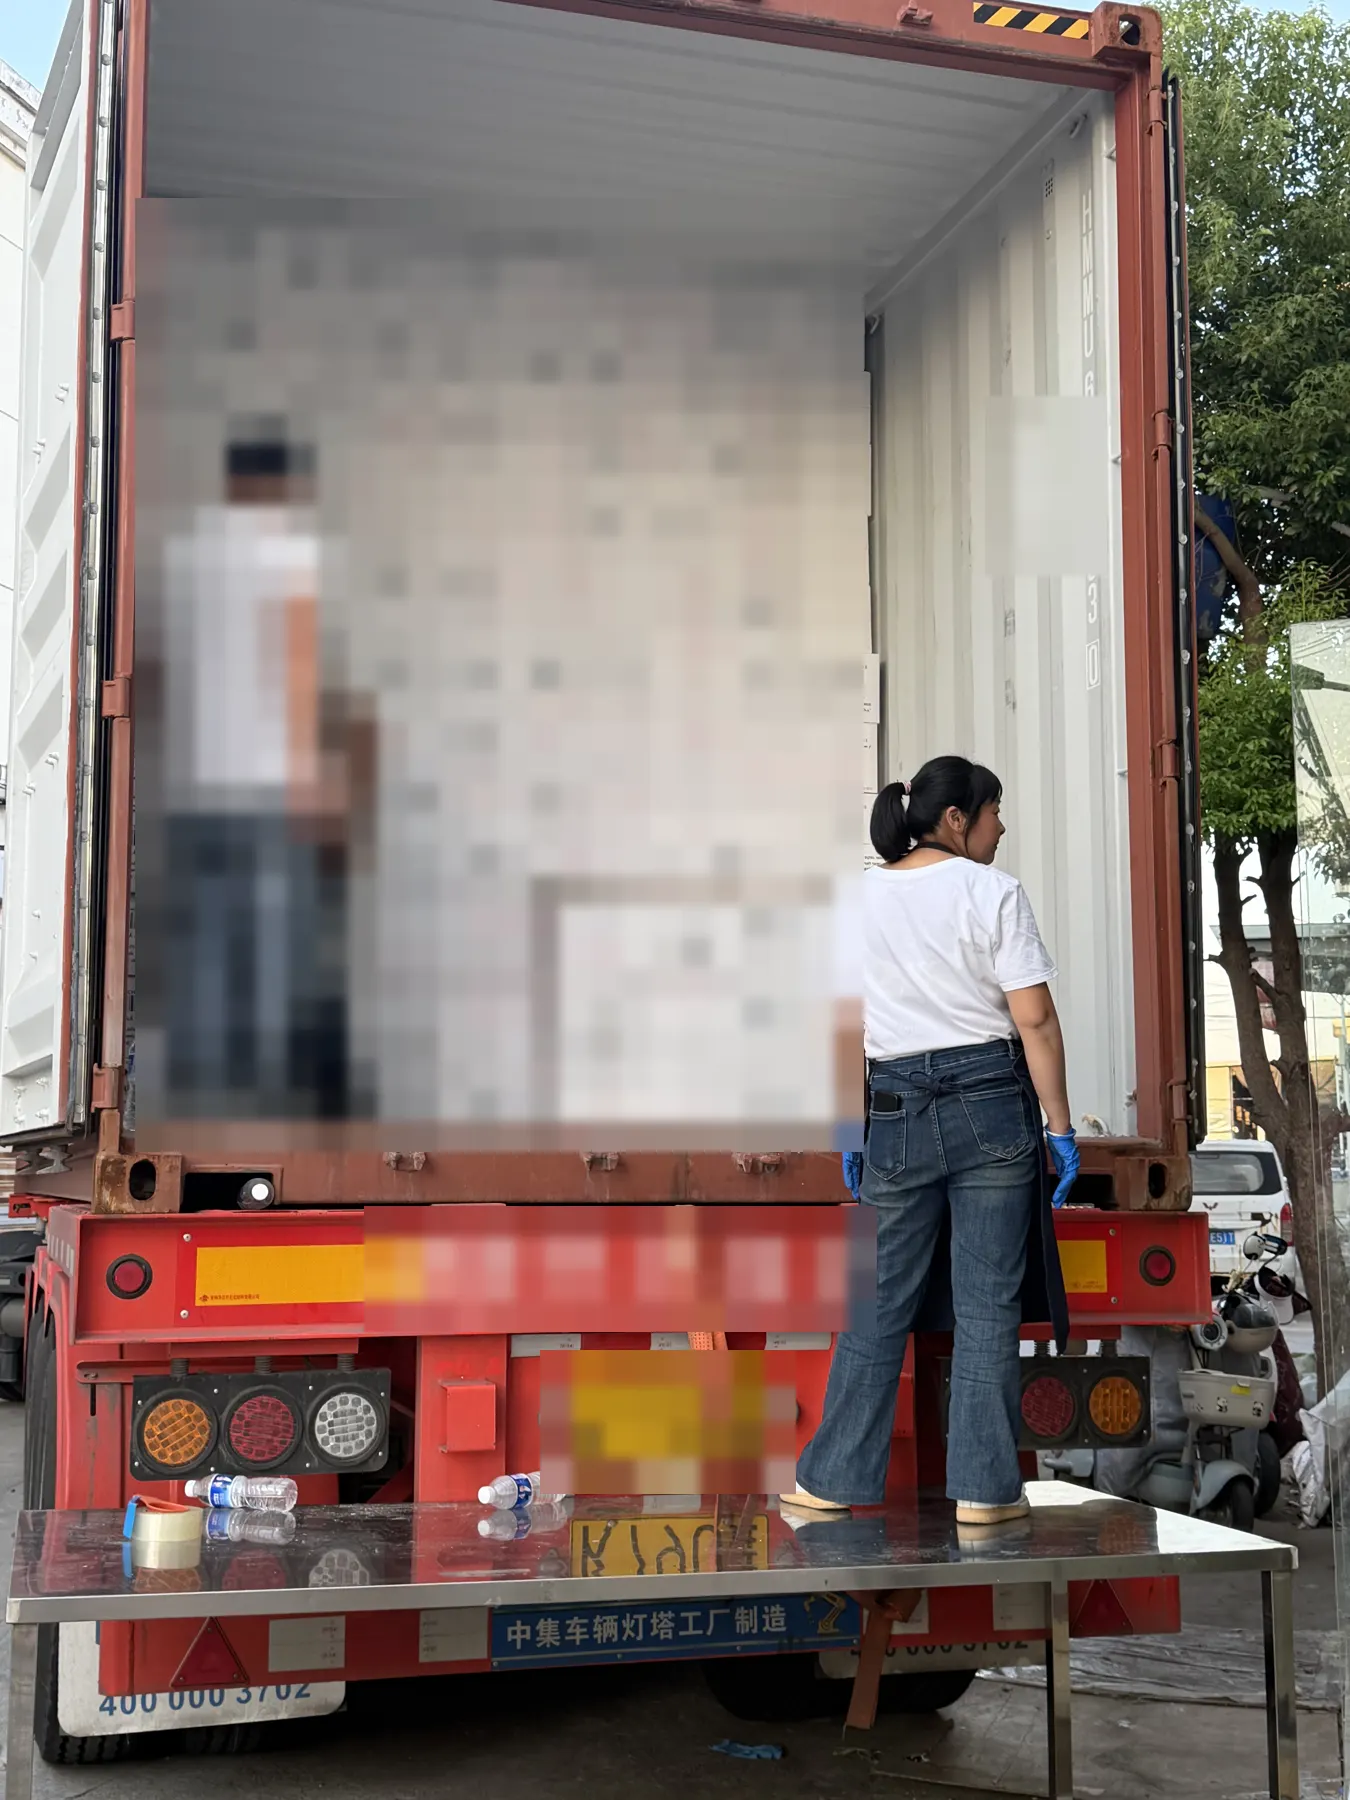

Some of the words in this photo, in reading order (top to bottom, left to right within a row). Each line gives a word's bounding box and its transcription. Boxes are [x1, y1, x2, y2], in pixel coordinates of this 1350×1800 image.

[1082, 189, 1094, 358] HMMU
[506, 1603, 787, 1650] 中集车辆灯塔工厂制造
[99, 1694, 157, 1717] 400
